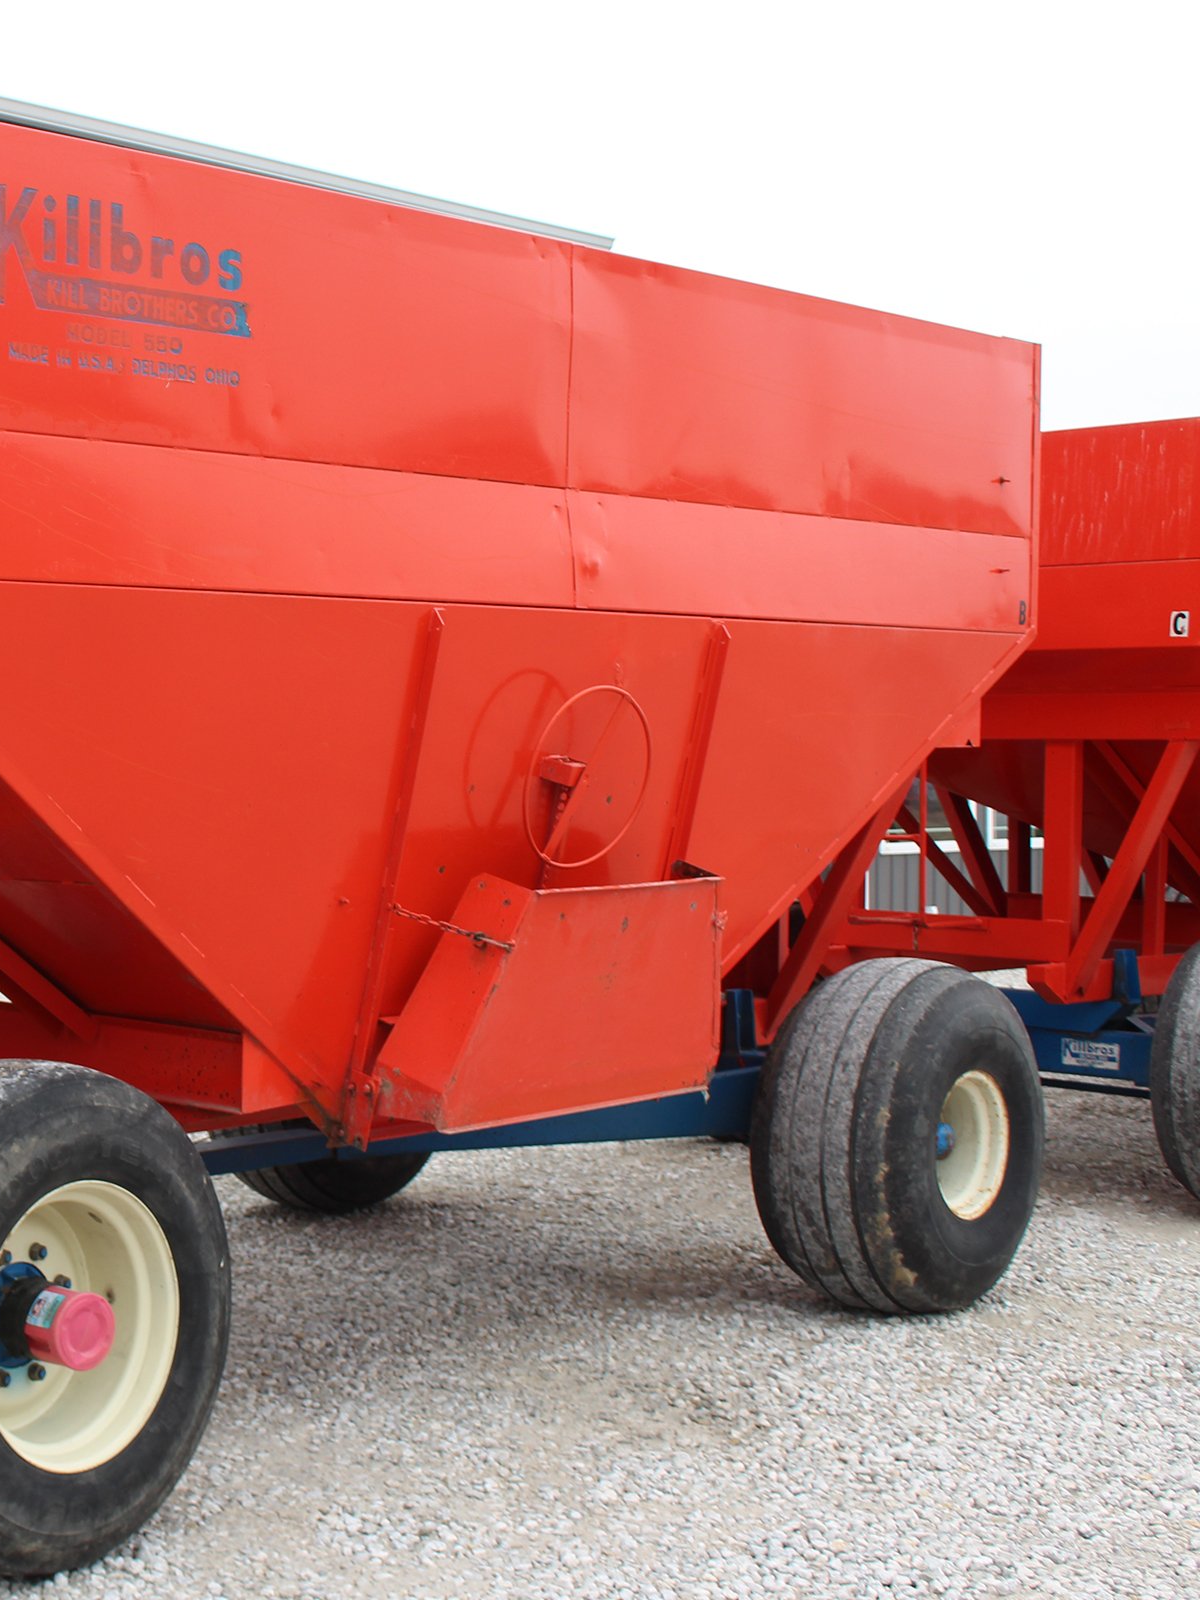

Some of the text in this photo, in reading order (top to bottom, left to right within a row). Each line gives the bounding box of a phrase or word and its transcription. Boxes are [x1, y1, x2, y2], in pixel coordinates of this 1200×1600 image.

[48, 279, 89, 310] KILL
[99, 287, 199, 324] BROTHERS
[66, 322, 131, 348] MODEL
[132, 359, 196, 382] DELPHOS
[205, 367, 240, 387] OHIO
[1018, 600, 1027, 625] B
[1173, 612, 1187, 635] C
